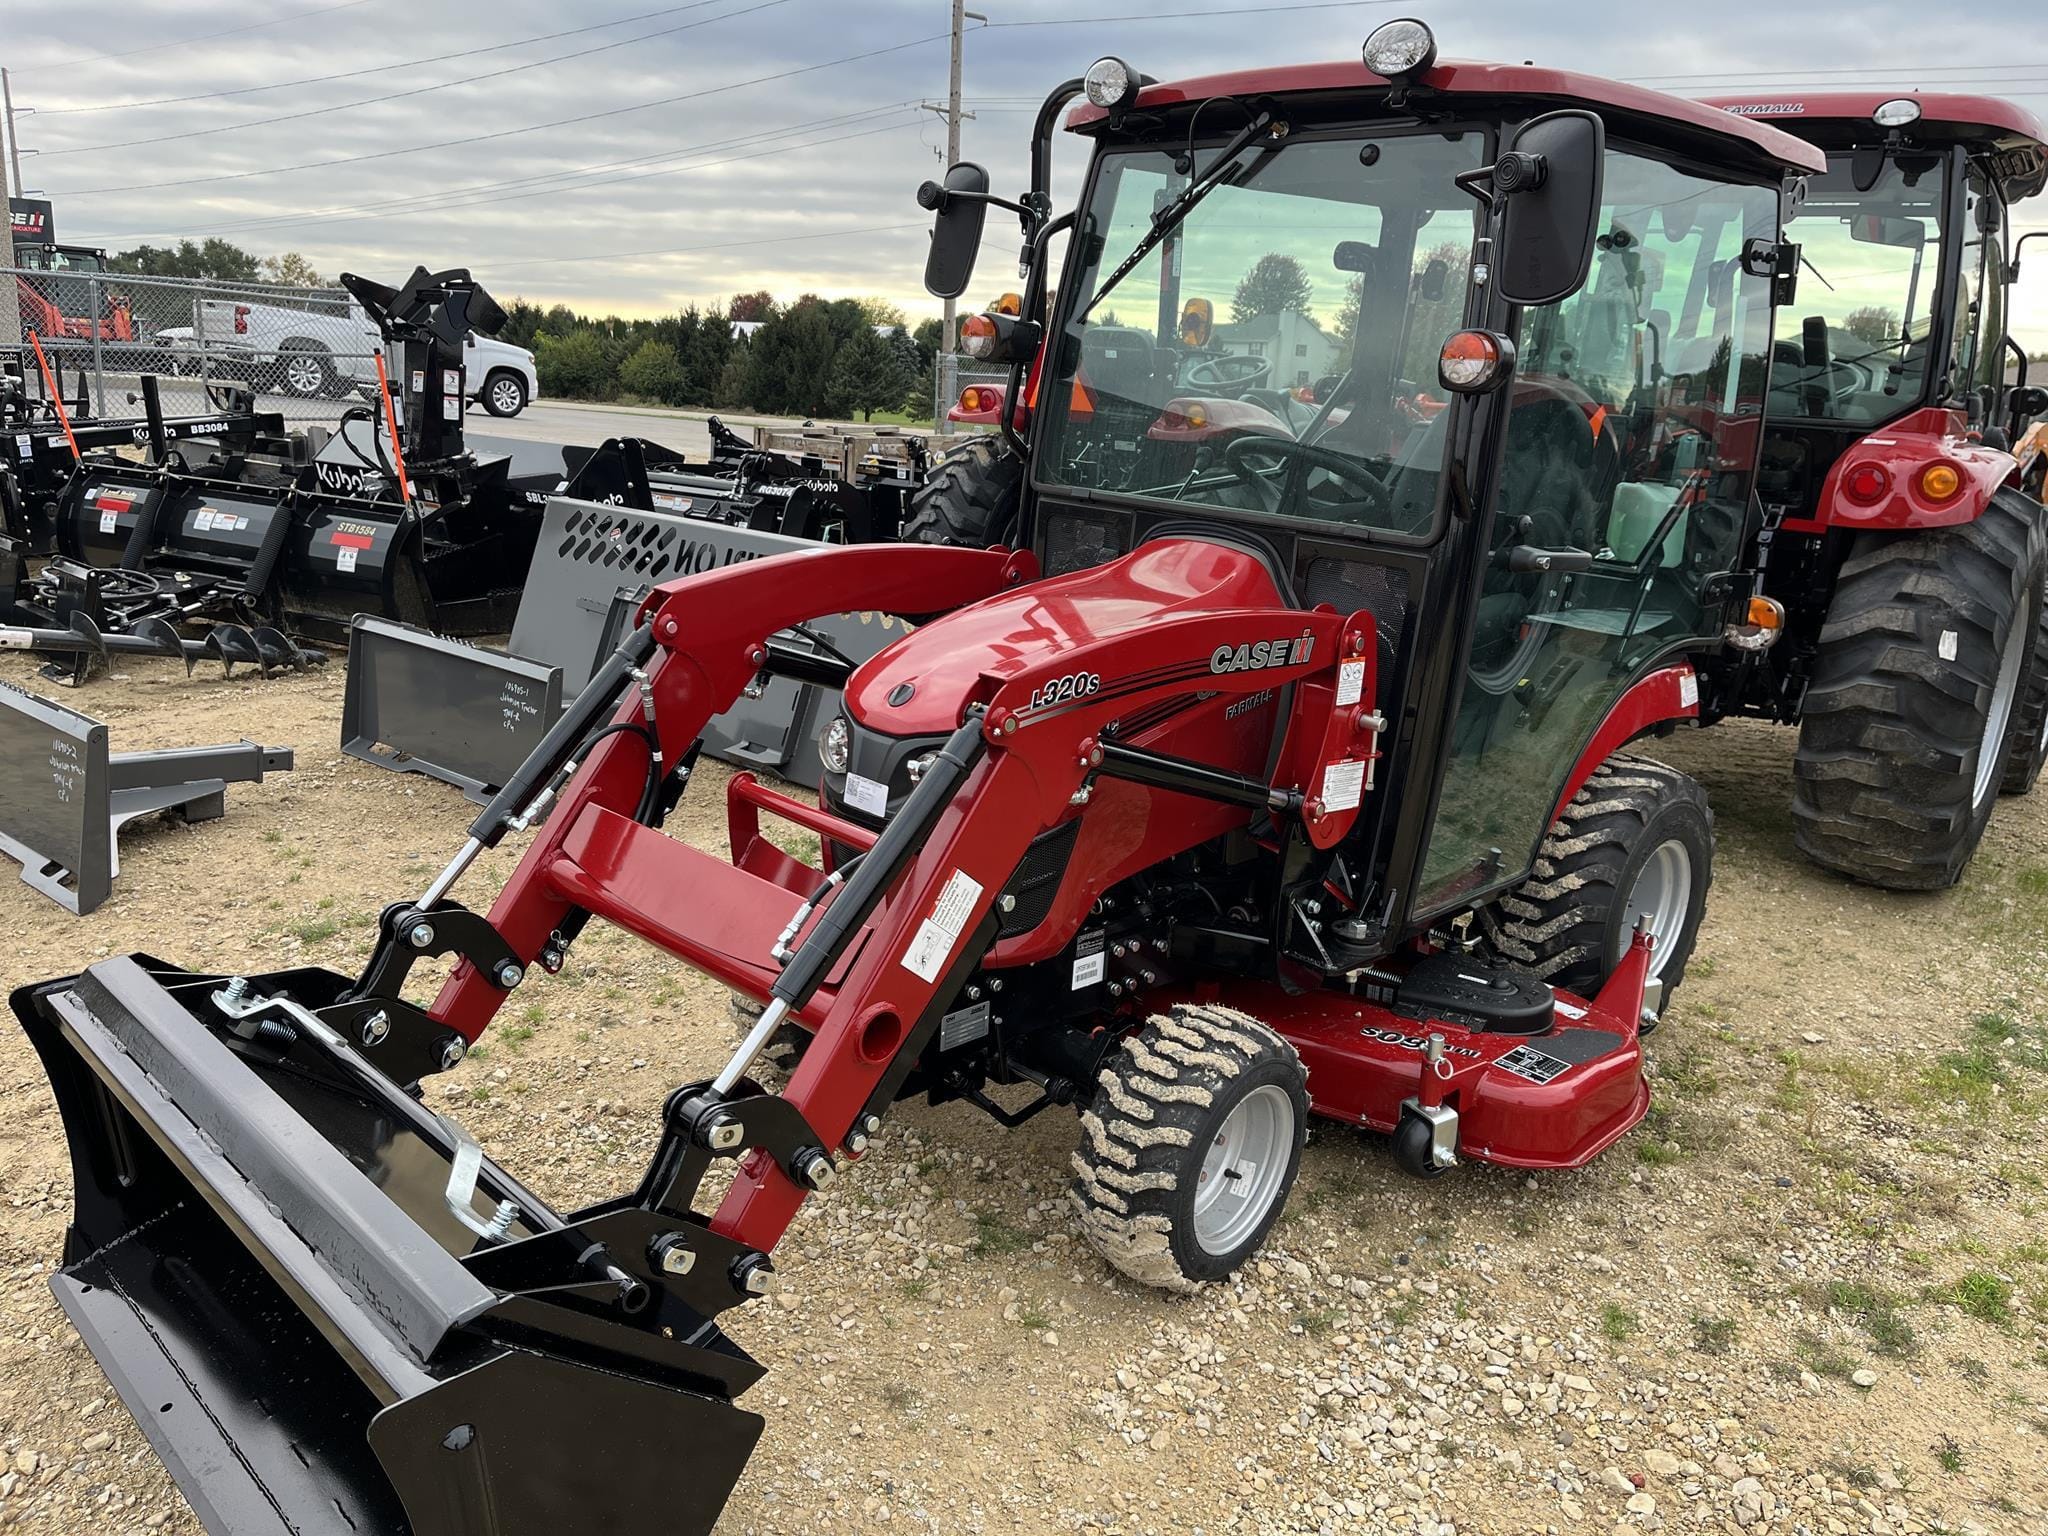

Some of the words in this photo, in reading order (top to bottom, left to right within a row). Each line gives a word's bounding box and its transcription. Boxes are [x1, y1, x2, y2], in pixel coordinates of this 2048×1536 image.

[133, 426, 177, 440] Kuta
[190, 422, 229, 434] BB3084
[337, 521, 376, 536] STB1584
[1209, 639, 1290, 675] CASE
[1225, 688, 1273, 721] FARMALL
